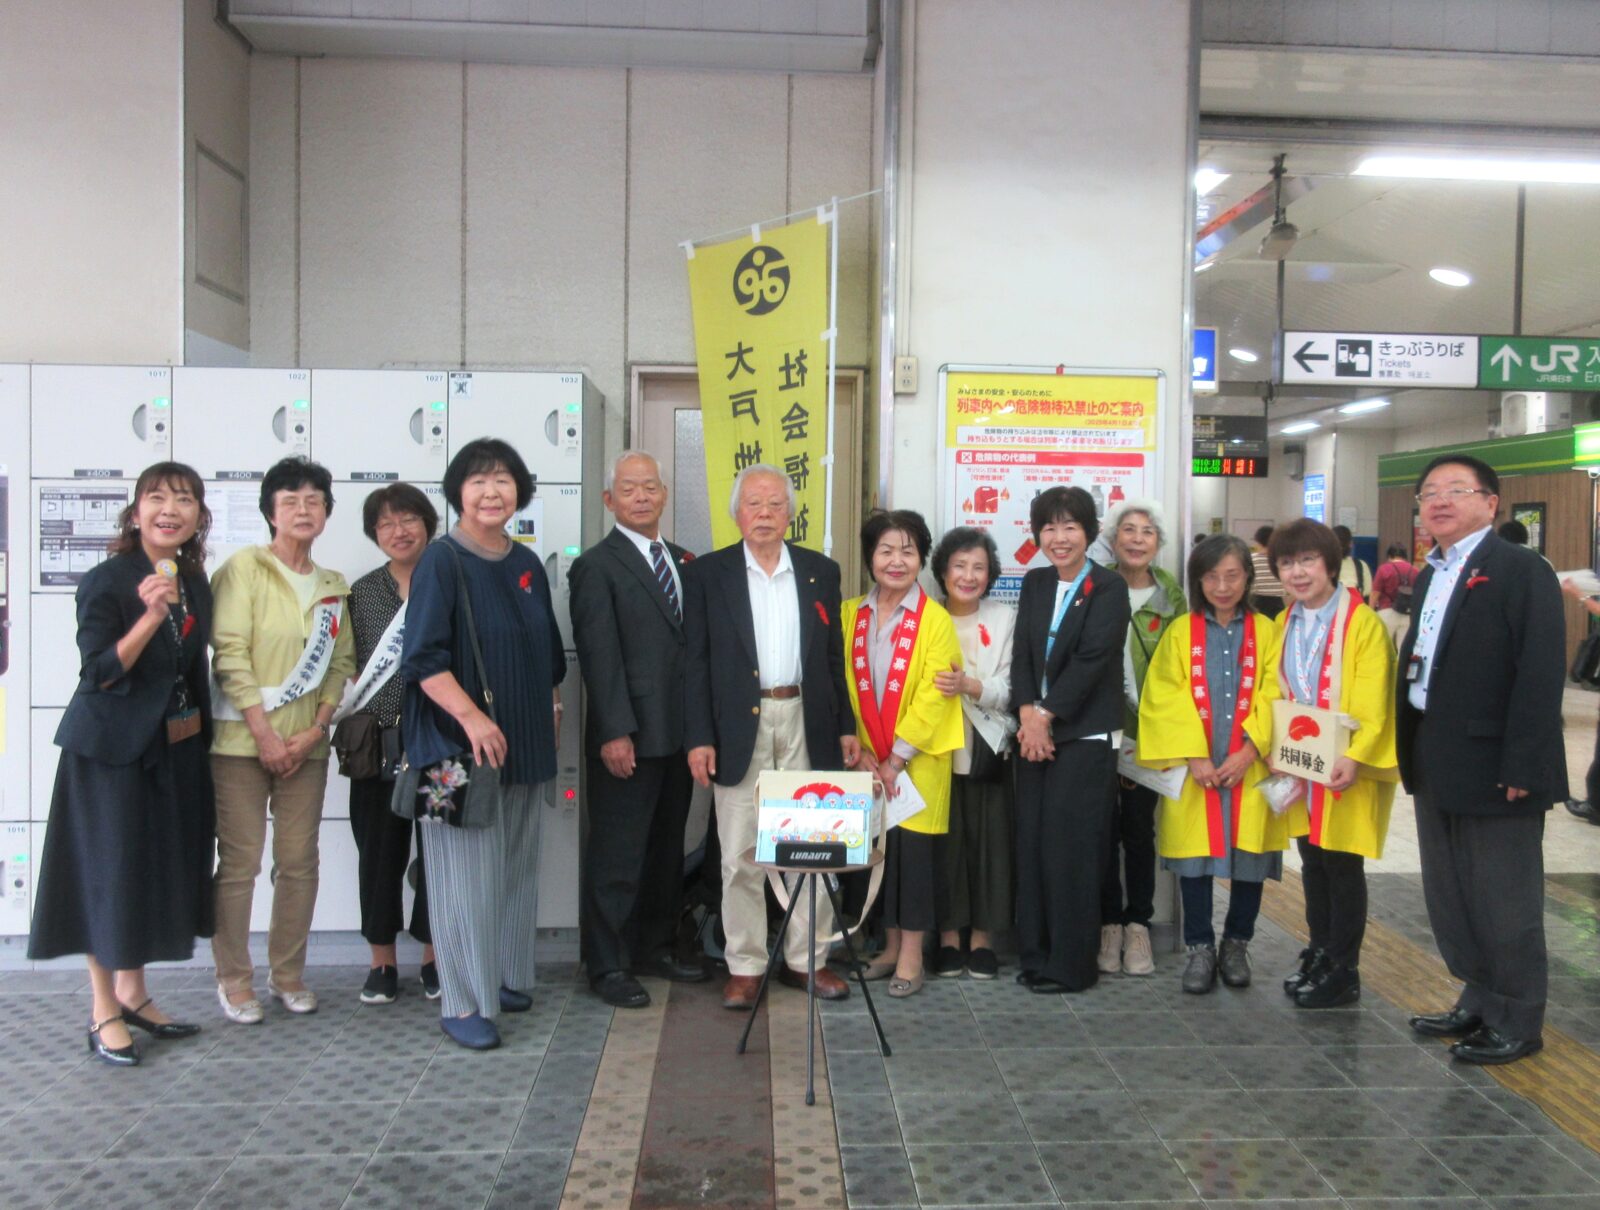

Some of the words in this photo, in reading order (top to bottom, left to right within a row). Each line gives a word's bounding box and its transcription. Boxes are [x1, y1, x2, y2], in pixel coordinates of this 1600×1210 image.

[1378, 341, 1465, 358] きっぷうりば
[1378, 359, 1412, 368] Tickets
[1530, 345, 1580, 373] JR
[1536, 374, 1573, 383] JR東日本
[854, 618, 871, 693] 共同募金
[888, 618, 917, 694] 共同募金
[1191, 645, 1209, 720] 共同募金
[1279, 745, 1326, 775] 共同募金
[789, 851, 833, 861] LUNAUTE
